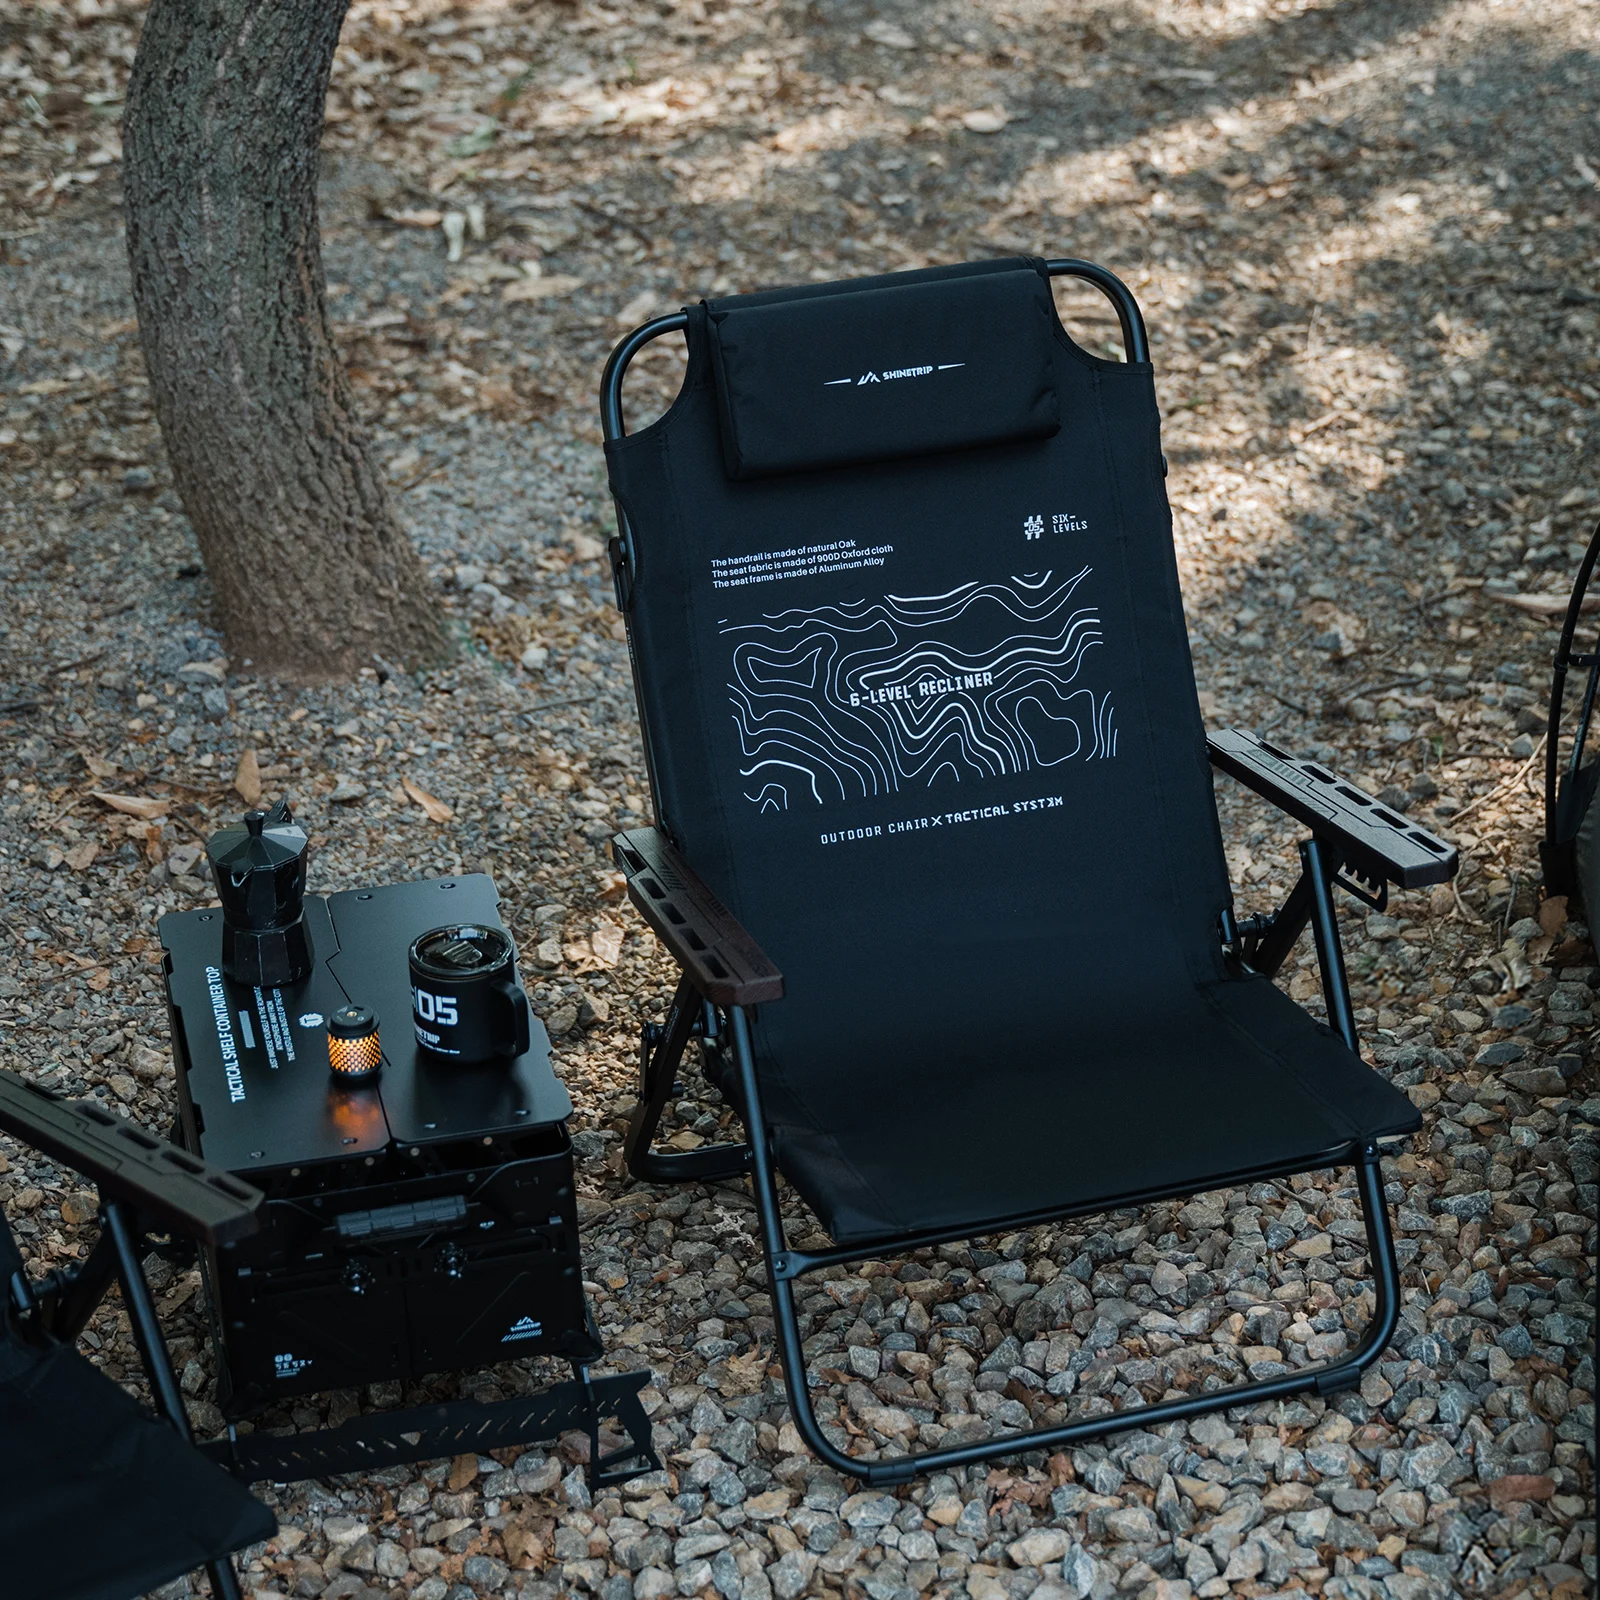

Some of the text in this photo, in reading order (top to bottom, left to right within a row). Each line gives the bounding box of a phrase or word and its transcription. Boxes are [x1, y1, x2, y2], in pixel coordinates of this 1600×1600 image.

[882, 365, 934, 380] SHINETRIP
[1052, 514, 1076, 524] SIX-
[1053, 520, 1088, 534] LEVELS
[711, 540, 856, 568] The handrail is made of natural Oak
[712, 544, 894, 578] The seat fabric is made of 900D Oxford cloth
[713, 556, 885, 589] The seat frame is made of Aluminum Alloy
[850, 672, 993, 707] 6-LEVEL RECLINER
[820, 825, 882, 844] OUTDOOR
[888, 818, 928, 834] CHAIR
[945, 805, 1010, 824] TACTICAL
[206, 966, 246, 1103] TACTICAL SHELF CONTAINER TOP
